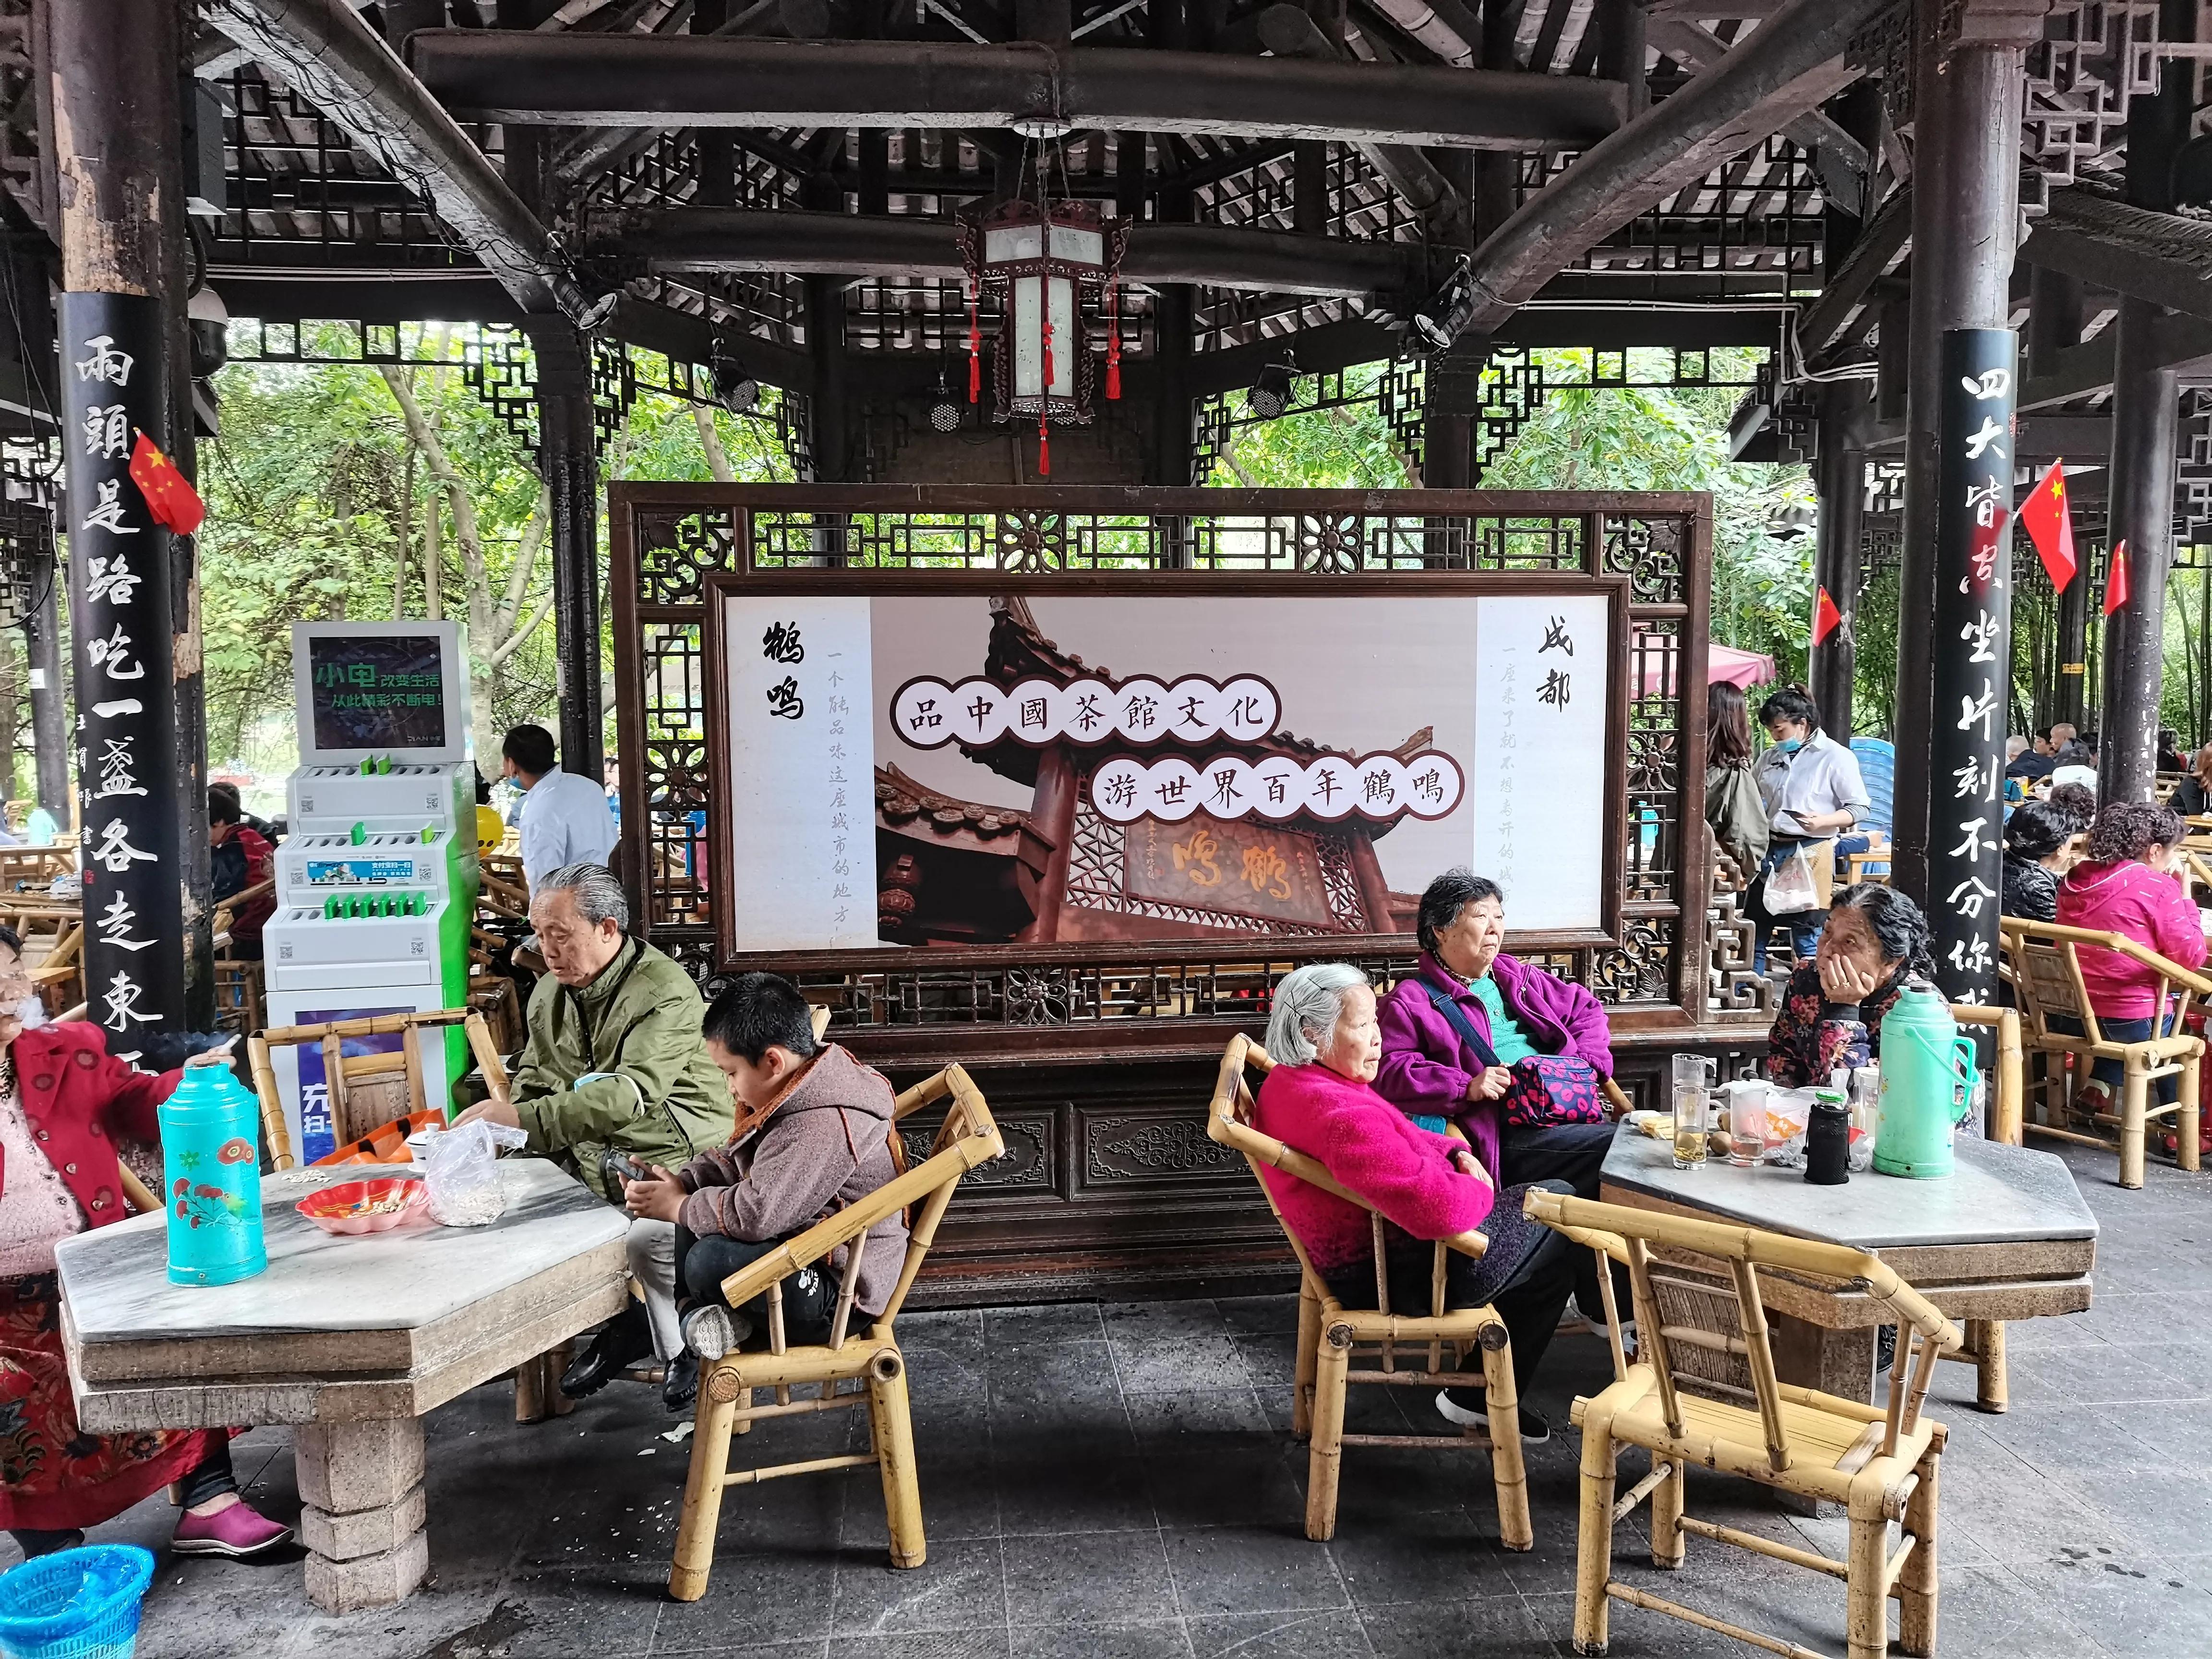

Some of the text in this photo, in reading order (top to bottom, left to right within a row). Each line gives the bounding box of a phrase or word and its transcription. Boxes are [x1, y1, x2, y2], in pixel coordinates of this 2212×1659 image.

[316, 662, 440, 688] 小电 改变生活
[1536, 615, 1573, 713] 成都
[909, 694, 1264, 733] 品中國茶館文化
[1104, 767, 1444, 809] 游世界百年鶴鳴
[303, 1115, 332, 1133] 扫
